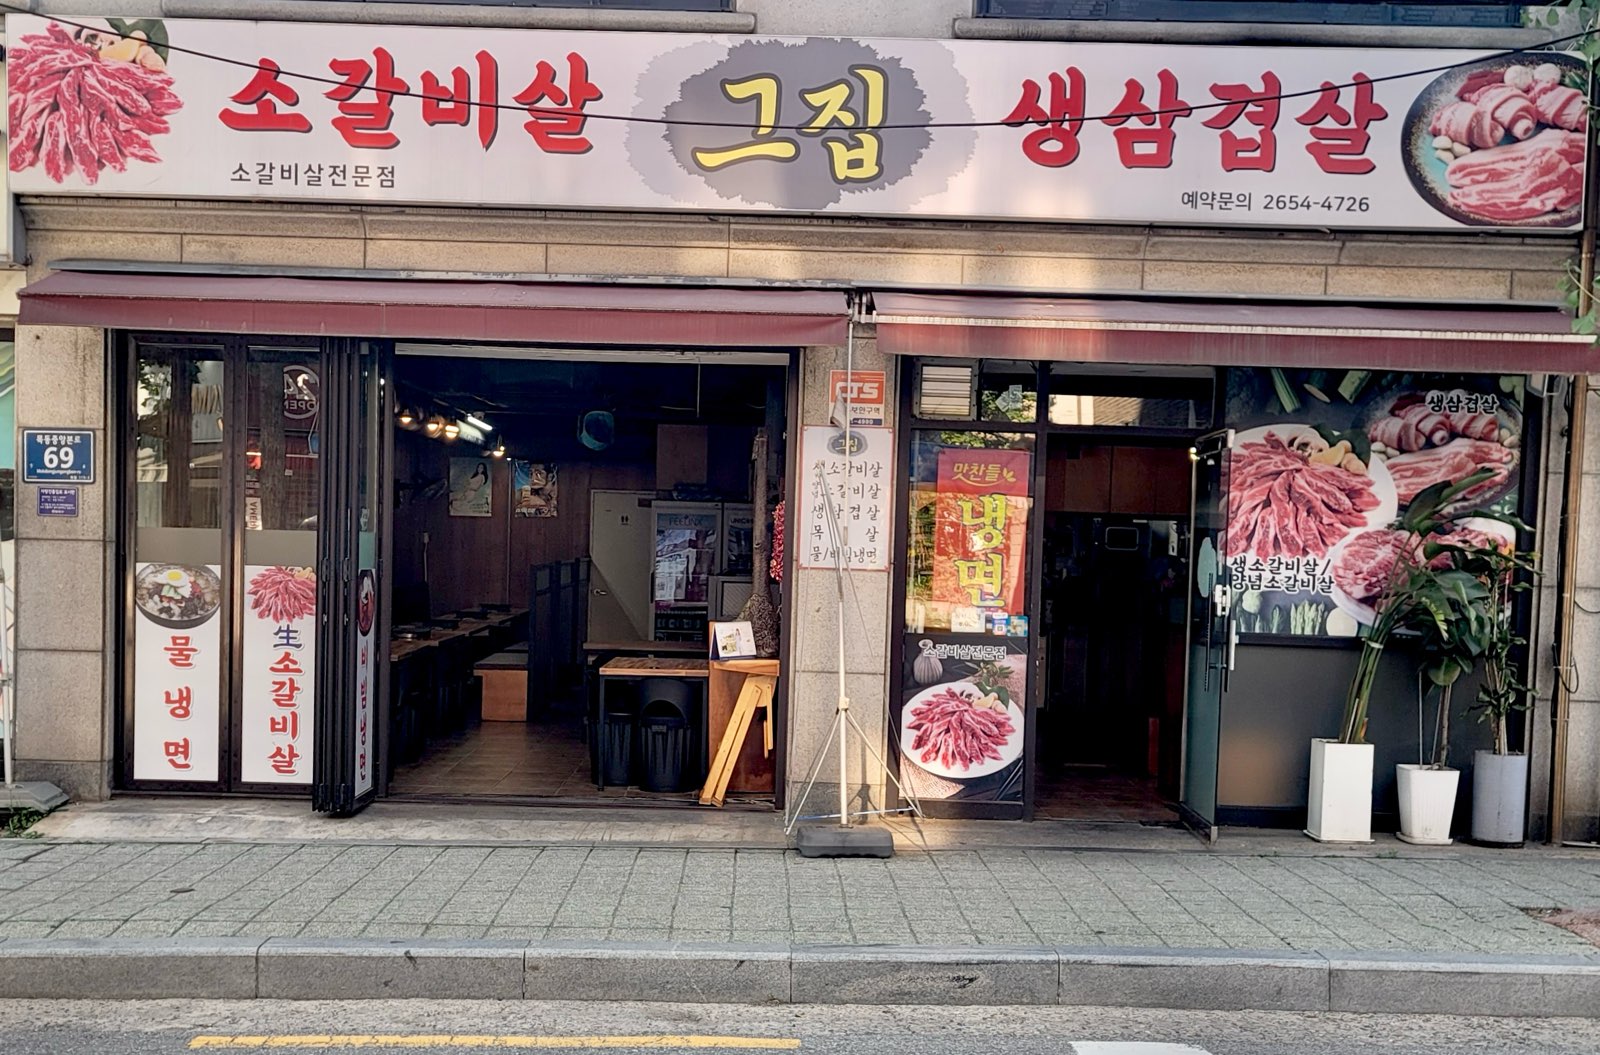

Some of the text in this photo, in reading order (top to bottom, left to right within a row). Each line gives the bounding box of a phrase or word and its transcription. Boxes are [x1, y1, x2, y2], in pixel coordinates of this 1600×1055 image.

[218, 46, 603, 154] 소갈비살
[693, 65, 888, 184] 그집
[1001, 66, 1389, 175] 생삼겹살
[230, 163, 396, 189] 소갈비살전문점
[1181, 191, 1370, 213] 예약문의 2654-4726
[1427, 393, 1499, 415] 생삼겹살
[43, 446, 74, 469] 69
[952, 462, 1001, 482] 맛찬들
[954, 493, 1008, 609] 냉면
[1230, 574, 1335, 594] 양념소갈비살
[922, 643, 1007, 661] 소갈비살전문점
